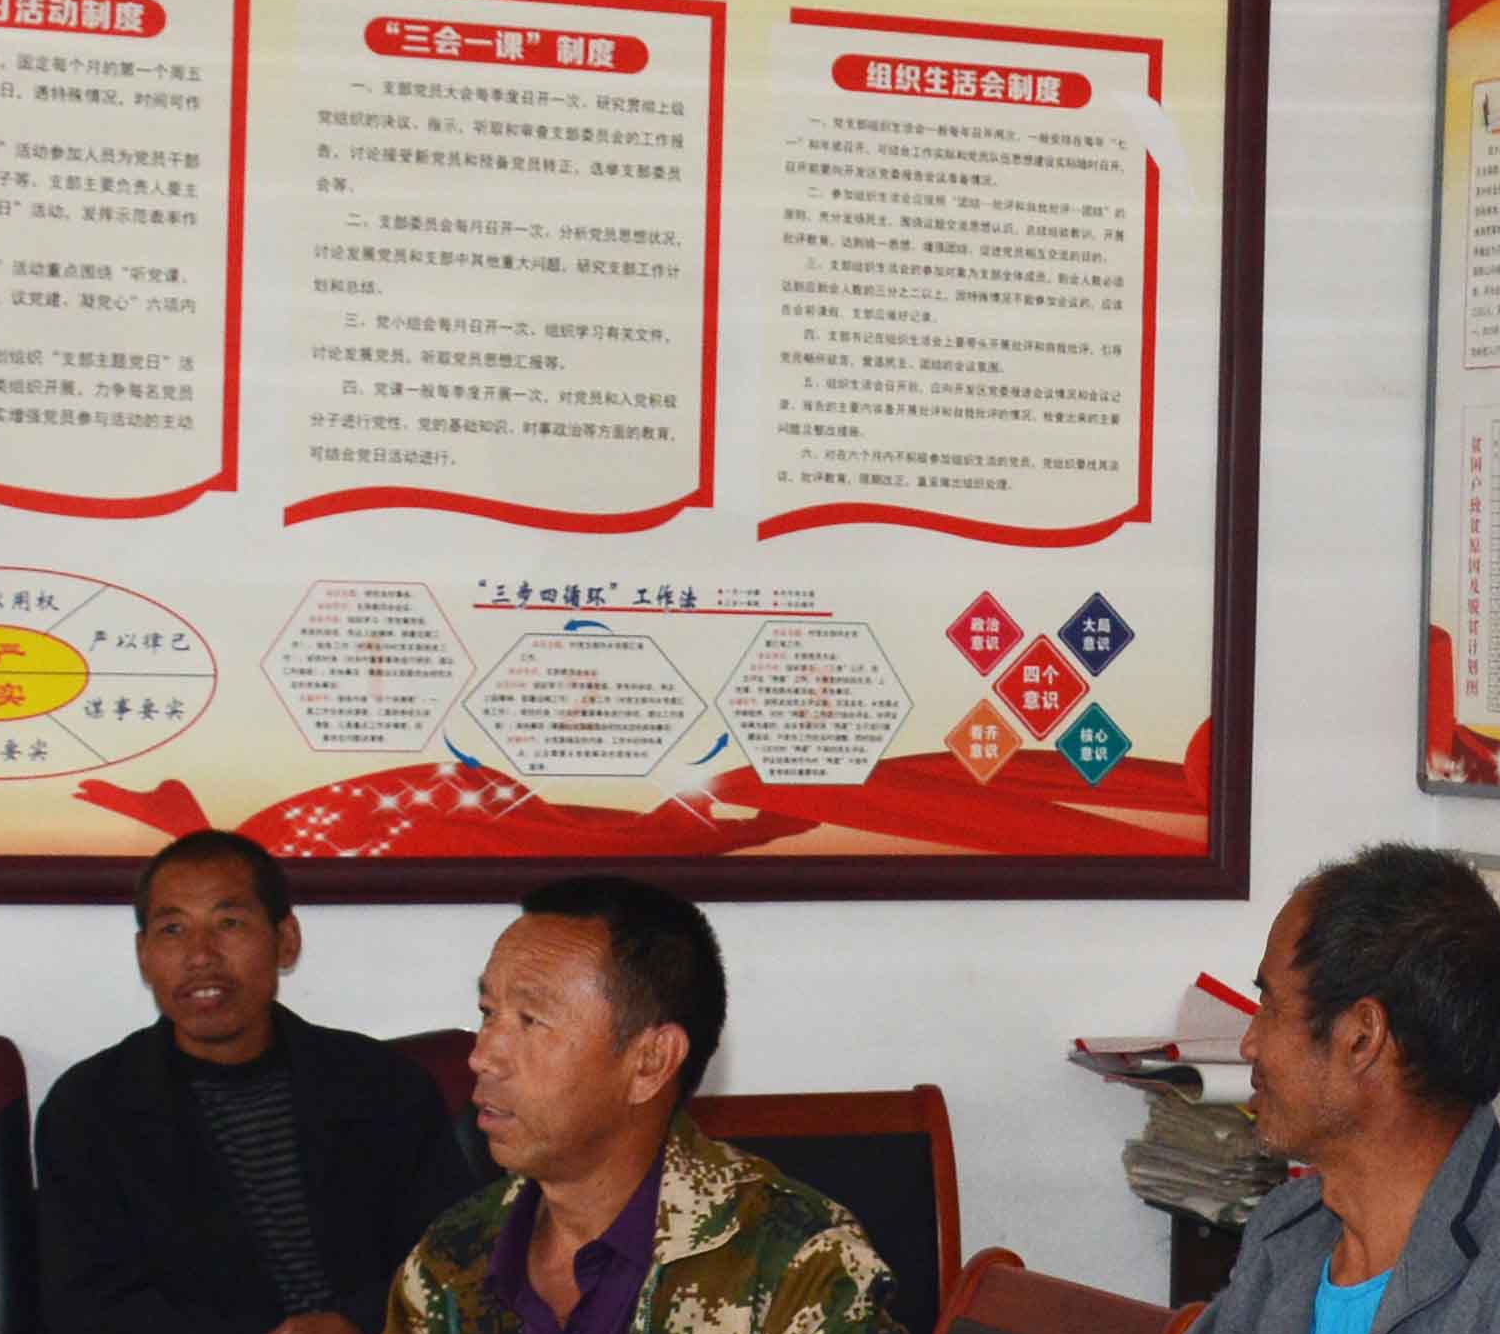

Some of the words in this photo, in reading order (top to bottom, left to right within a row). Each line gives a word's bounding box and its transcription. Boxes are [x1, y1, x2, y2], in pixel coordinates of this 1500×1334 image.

[385, 21, 616, 68] “三会一课”制度
[866, 62, 1062, 105] 组织生活会制度
[478, 578, 698, 610] “三步四循环”工作法
[88, 630, 191, 652] 严以律己
[971, 636, 1000, 651] 意识
[1082, 637, 1111, 652] 意识
[1023, 666, 1060, 684] 四个
[85, 698, 186, 721] 谋事要实
[1022, 691, 1060, 710] 意识
[1080, 747, 1108, 762] 意识
